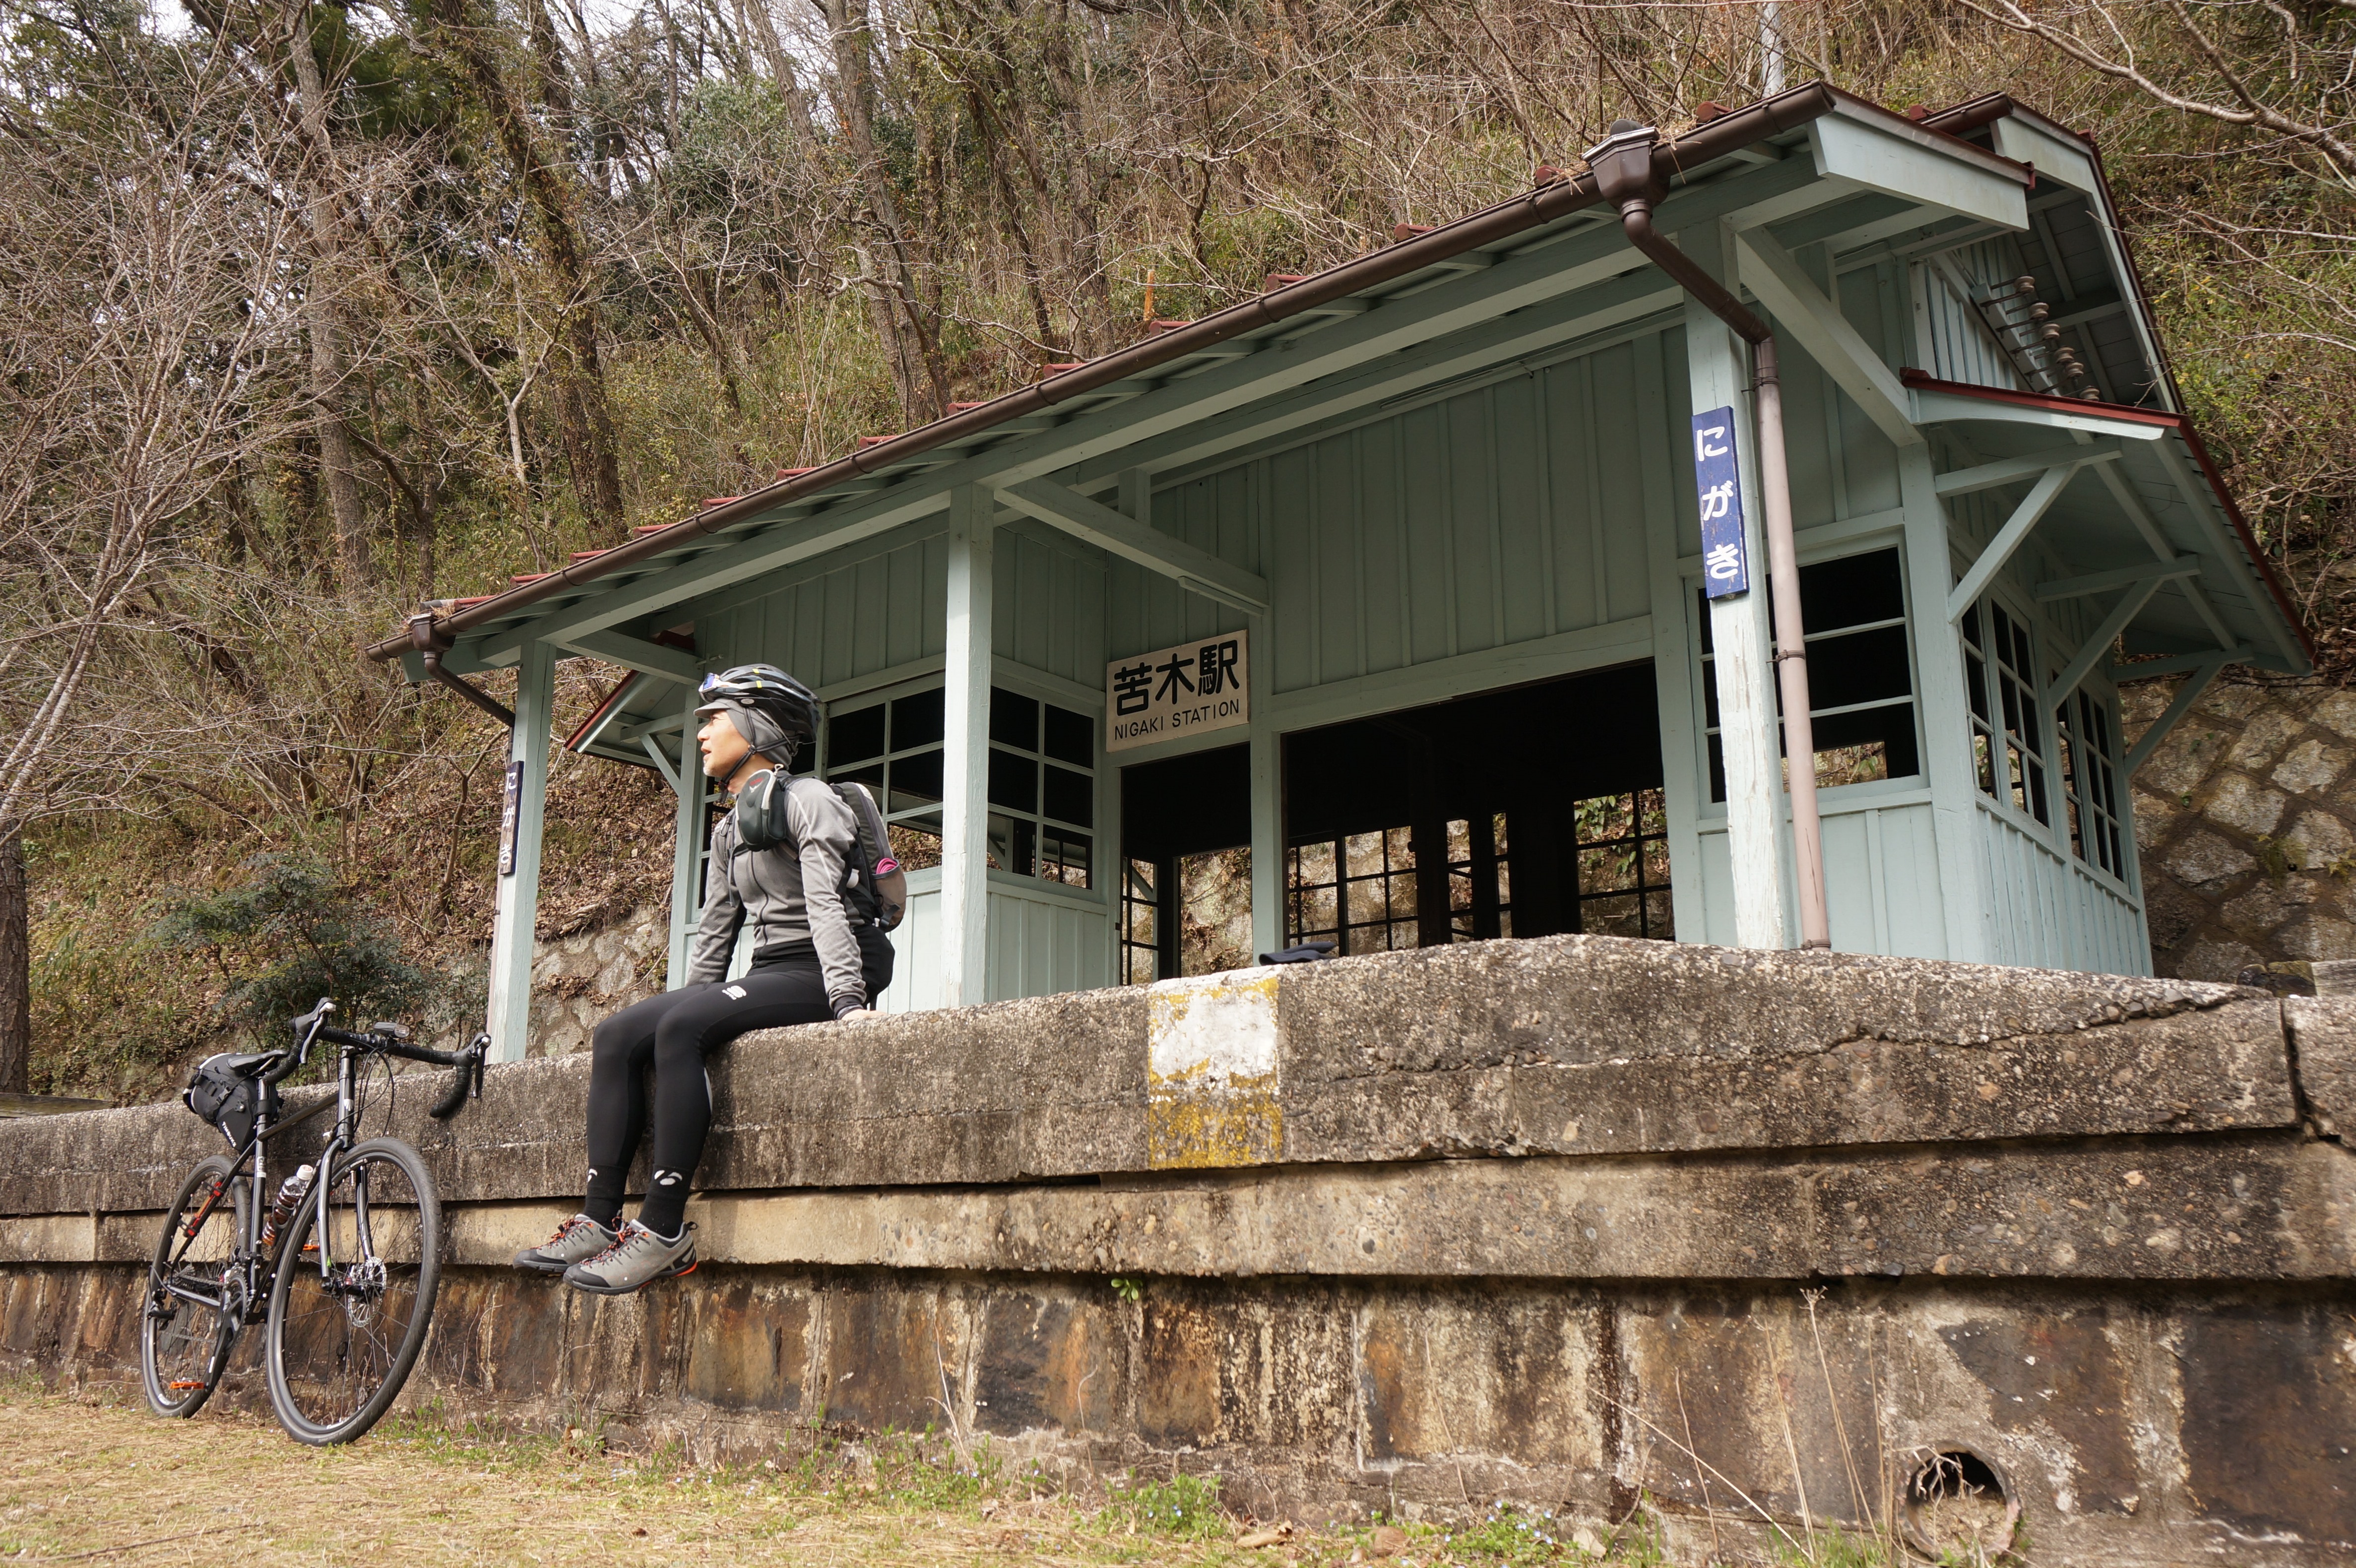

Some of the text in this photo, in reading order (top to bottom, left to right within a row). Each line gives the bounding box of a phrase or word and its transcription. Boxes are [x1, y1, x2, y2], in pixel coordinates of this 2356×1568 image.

[1697, 426, 1739, 579] にがき
[1114, 639, 1239, 716] 苦木駅
[1115, 698, 1239, 740] NIGAKI STATION
[501, 772, 516, 864] にがき
